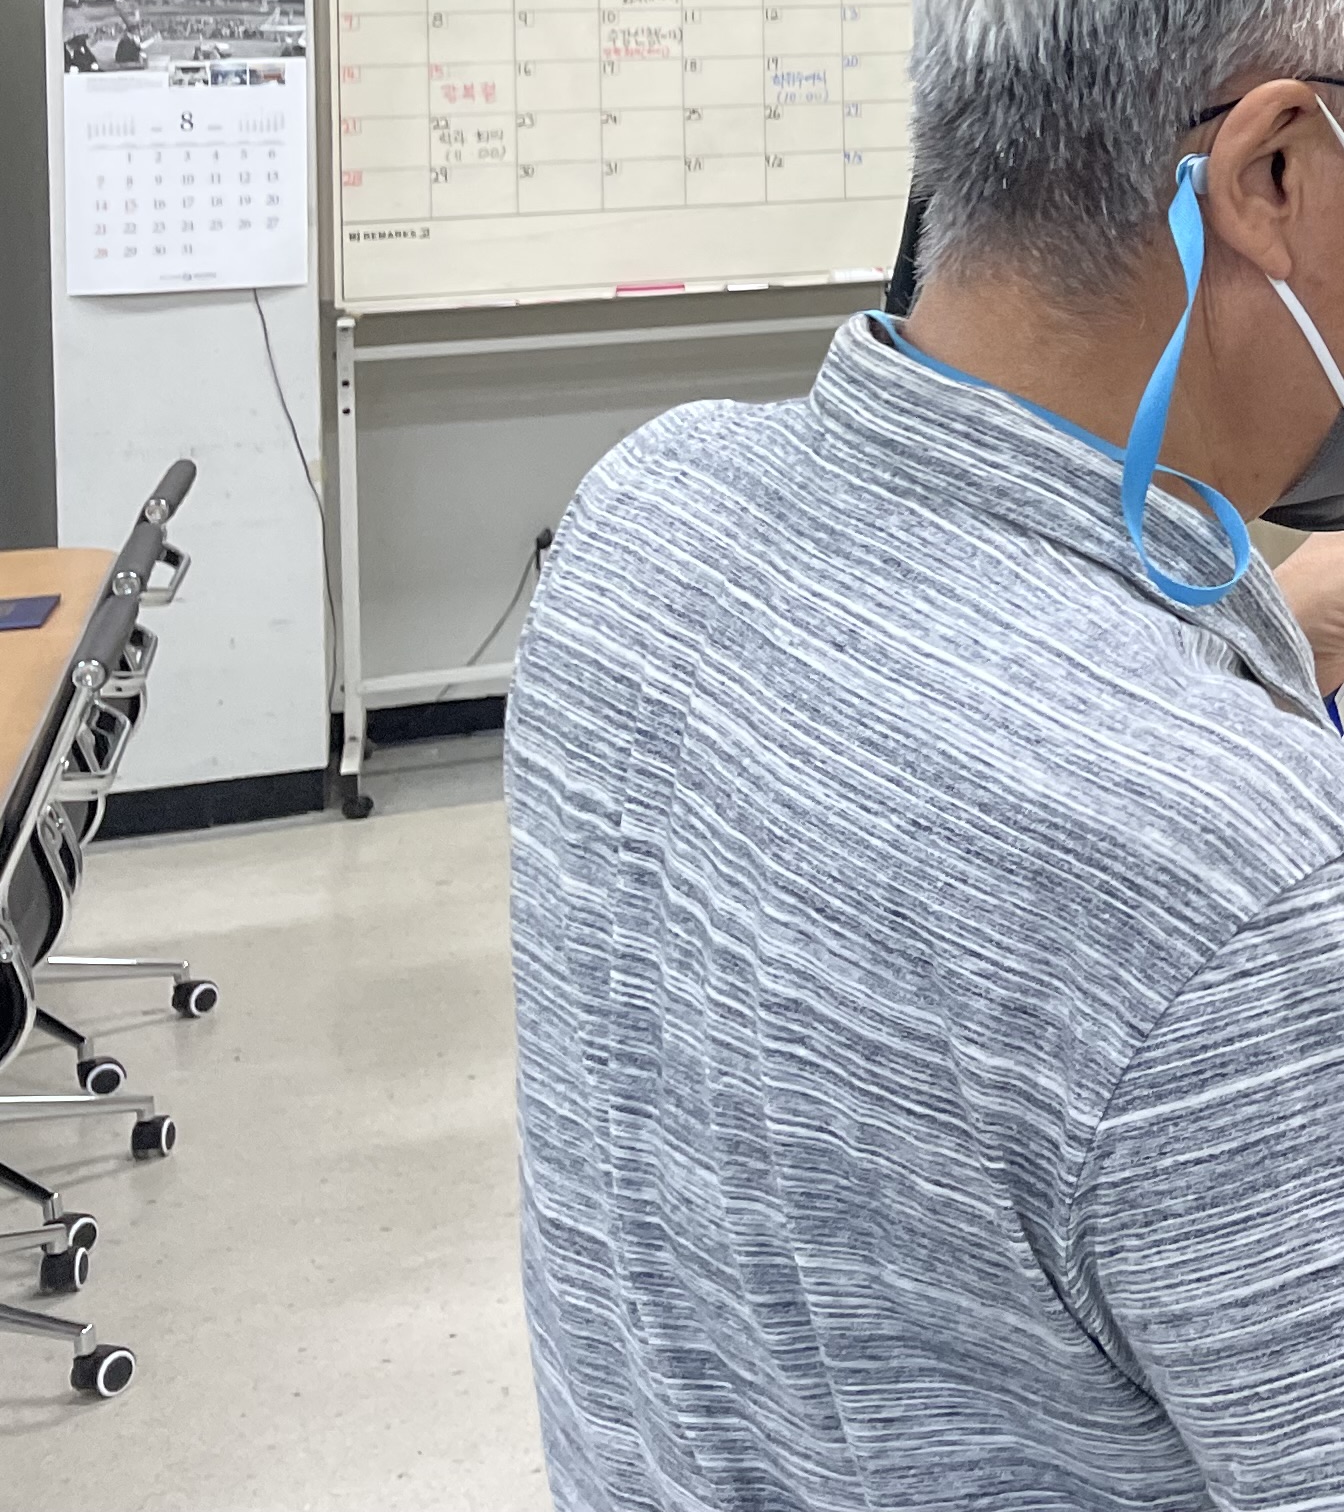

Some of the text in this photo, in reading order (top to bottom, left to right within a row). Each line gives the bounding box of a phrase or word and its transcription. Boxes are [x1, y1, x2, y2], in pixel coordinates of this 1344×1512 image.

[602, 9, 616, 24] 10
[684, 9, 695, 23] 11
[602, 59, 615, 75] 17
[767, 56, 779, 71] 19
[764, 104, 781, 120] 26
[180, 110, 195, 132] 8
[431, 166, 448, 183] 29
